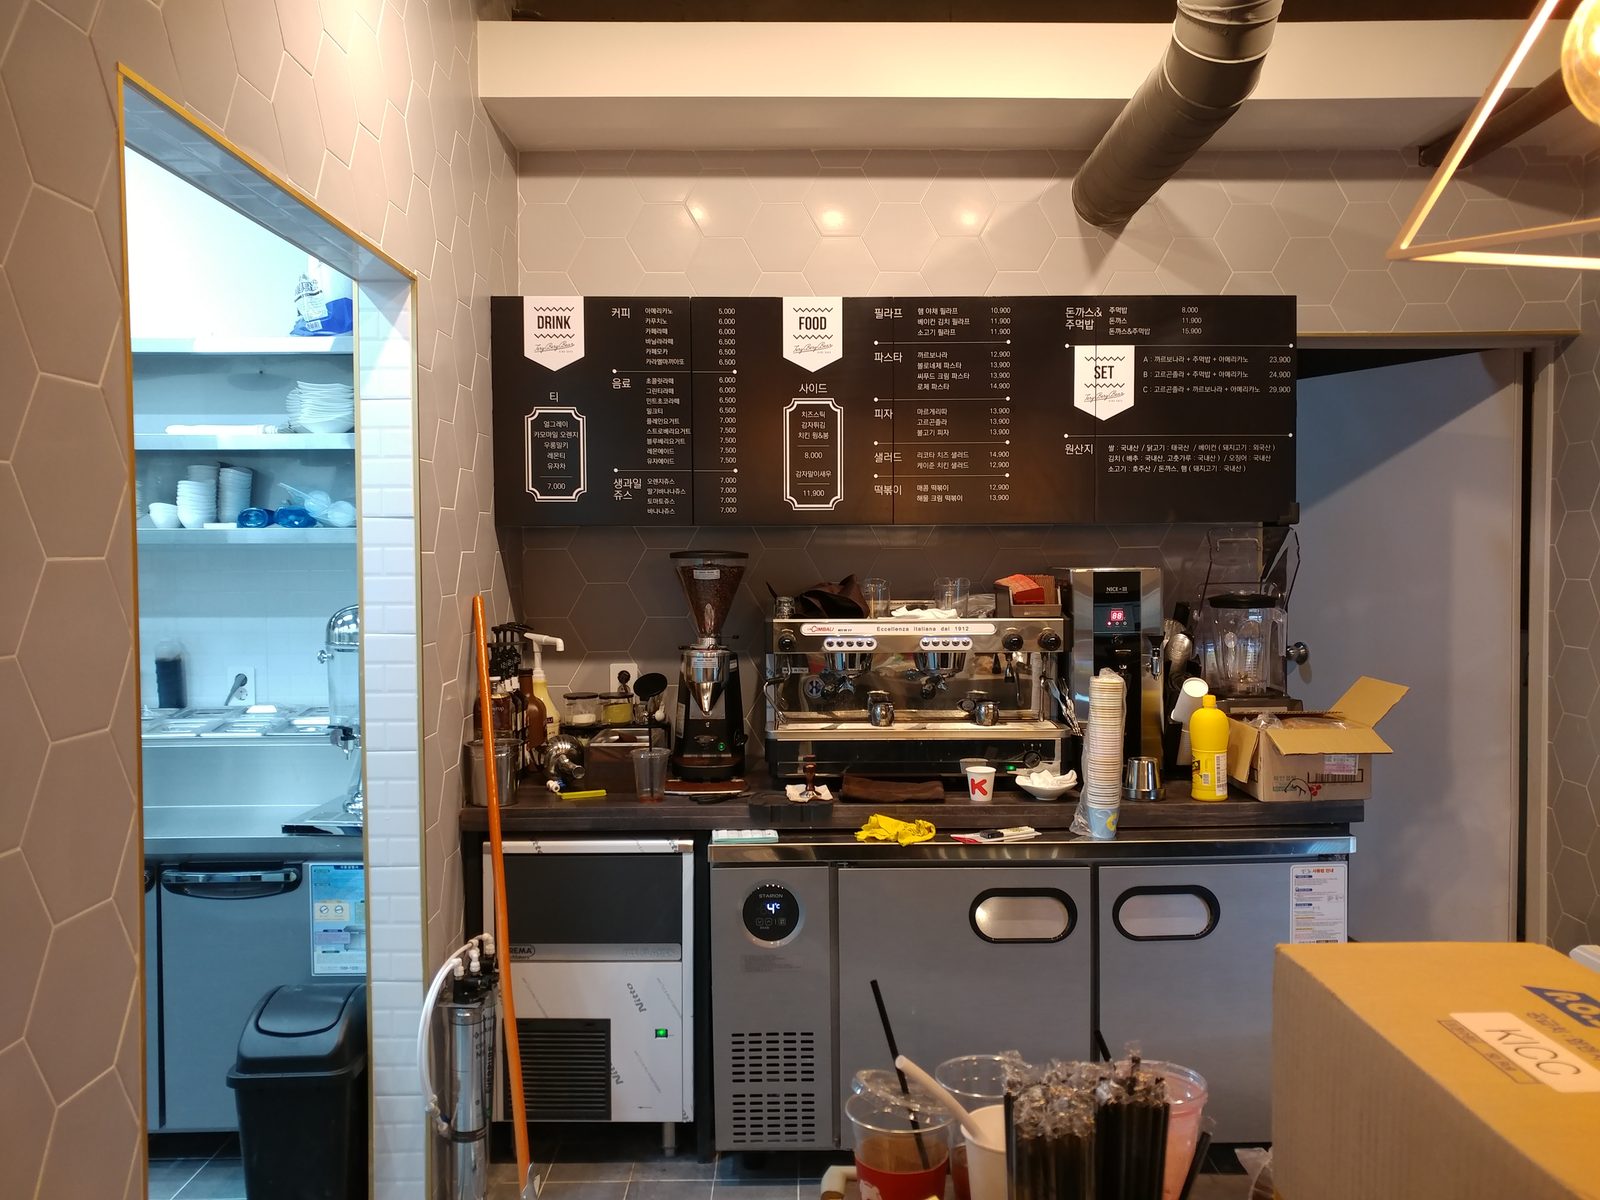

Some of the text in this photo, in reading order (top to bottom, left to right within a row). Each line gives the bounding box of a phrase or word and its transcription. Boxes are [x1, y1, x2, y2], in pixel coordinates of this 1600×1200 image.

[612, 308, 630, 318] 커피
[874, 308, 902, 319] 필라프
[1066, 307, 1102, 318] 돈까스&
[538, 316, 571, 329] DRINK
[799, 317, 826, 330] FOOD
[1066, 319, 1094, 330] 주먹밥
[874, 352, 902, 363] 파스타
[1094, 366, 1114, 379] SET
[612, 378, 631, 389] 음료
[799, 384, 827, 393] 사이드
[550, 392, 558, 402] 티
[875, 409, 893, 419] 피자
[1065, 444, 1093, 454] 원산지
[874, 452, 902, 463] 샐러드
[614, 478, 641, 491] 생과일
[875, 485, 901, 495] 떡볶이
[614, 490, 632, 500] 쥬스
[971, 778, 987, 795] K
[1485, 1028, 1581, 1076] KICC
